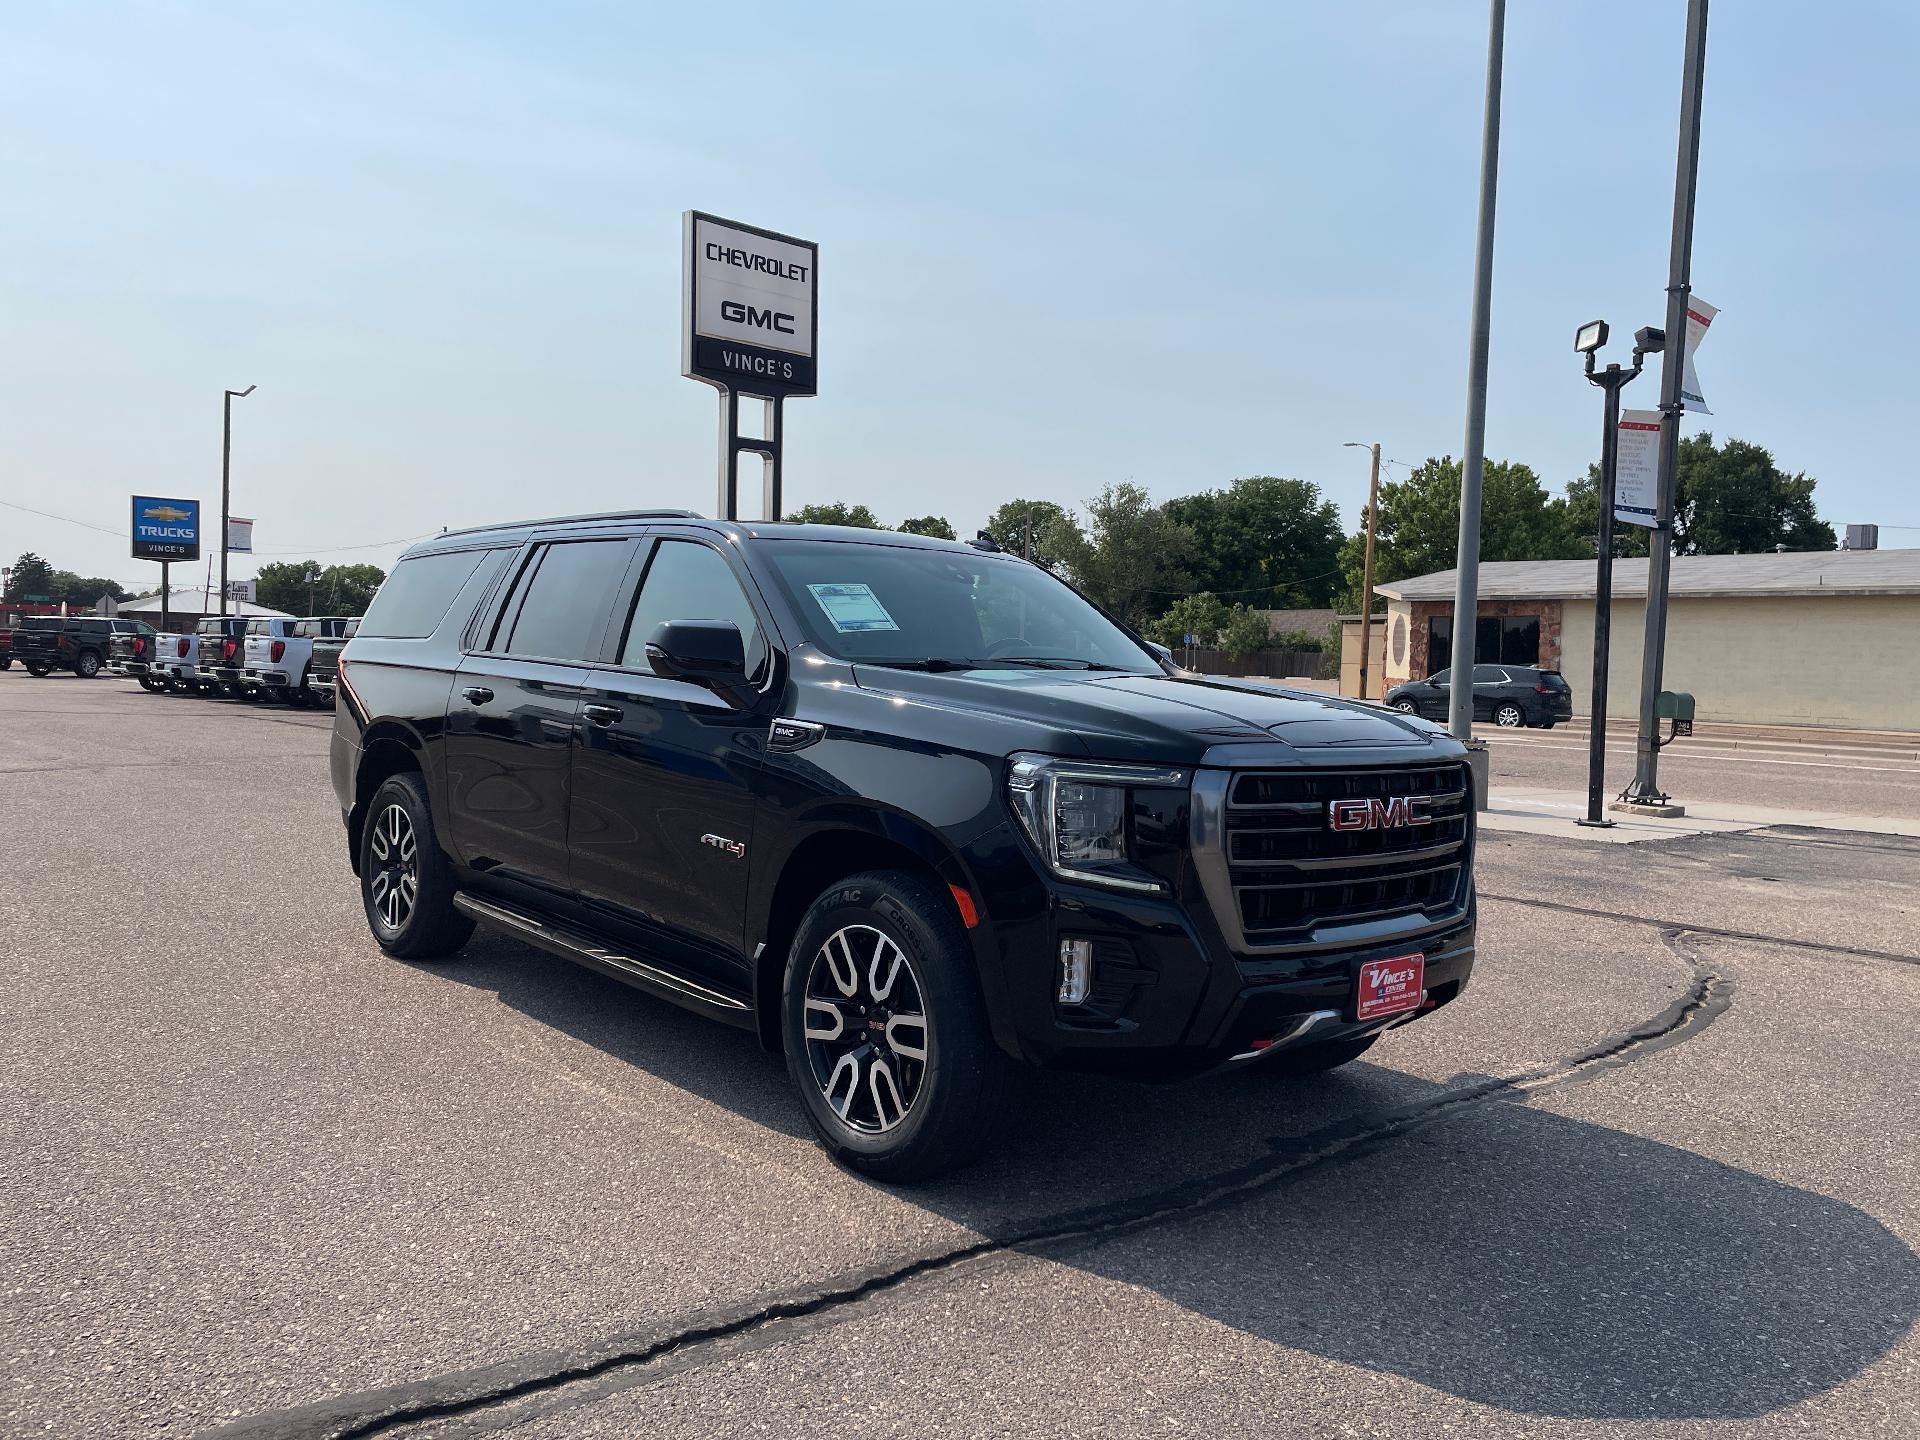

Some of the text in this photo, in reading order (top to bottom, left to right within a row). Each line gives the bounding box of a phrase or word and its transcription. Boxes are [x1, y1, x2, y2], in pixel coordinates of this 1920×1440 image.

[706, 243, 808, 282] CHEVROLET
[721, 300, 795, 334] GMC
[722, 350, 793, 379] VINCE'S
[139, 525, 195, 539] TRUCKS
[148, 544, 185, 553] VINCE'S
[775, 727, 795, 737] GMC
[1330, 795, 1432, 831] GMC
[701, 833, 745, 859] AT4
